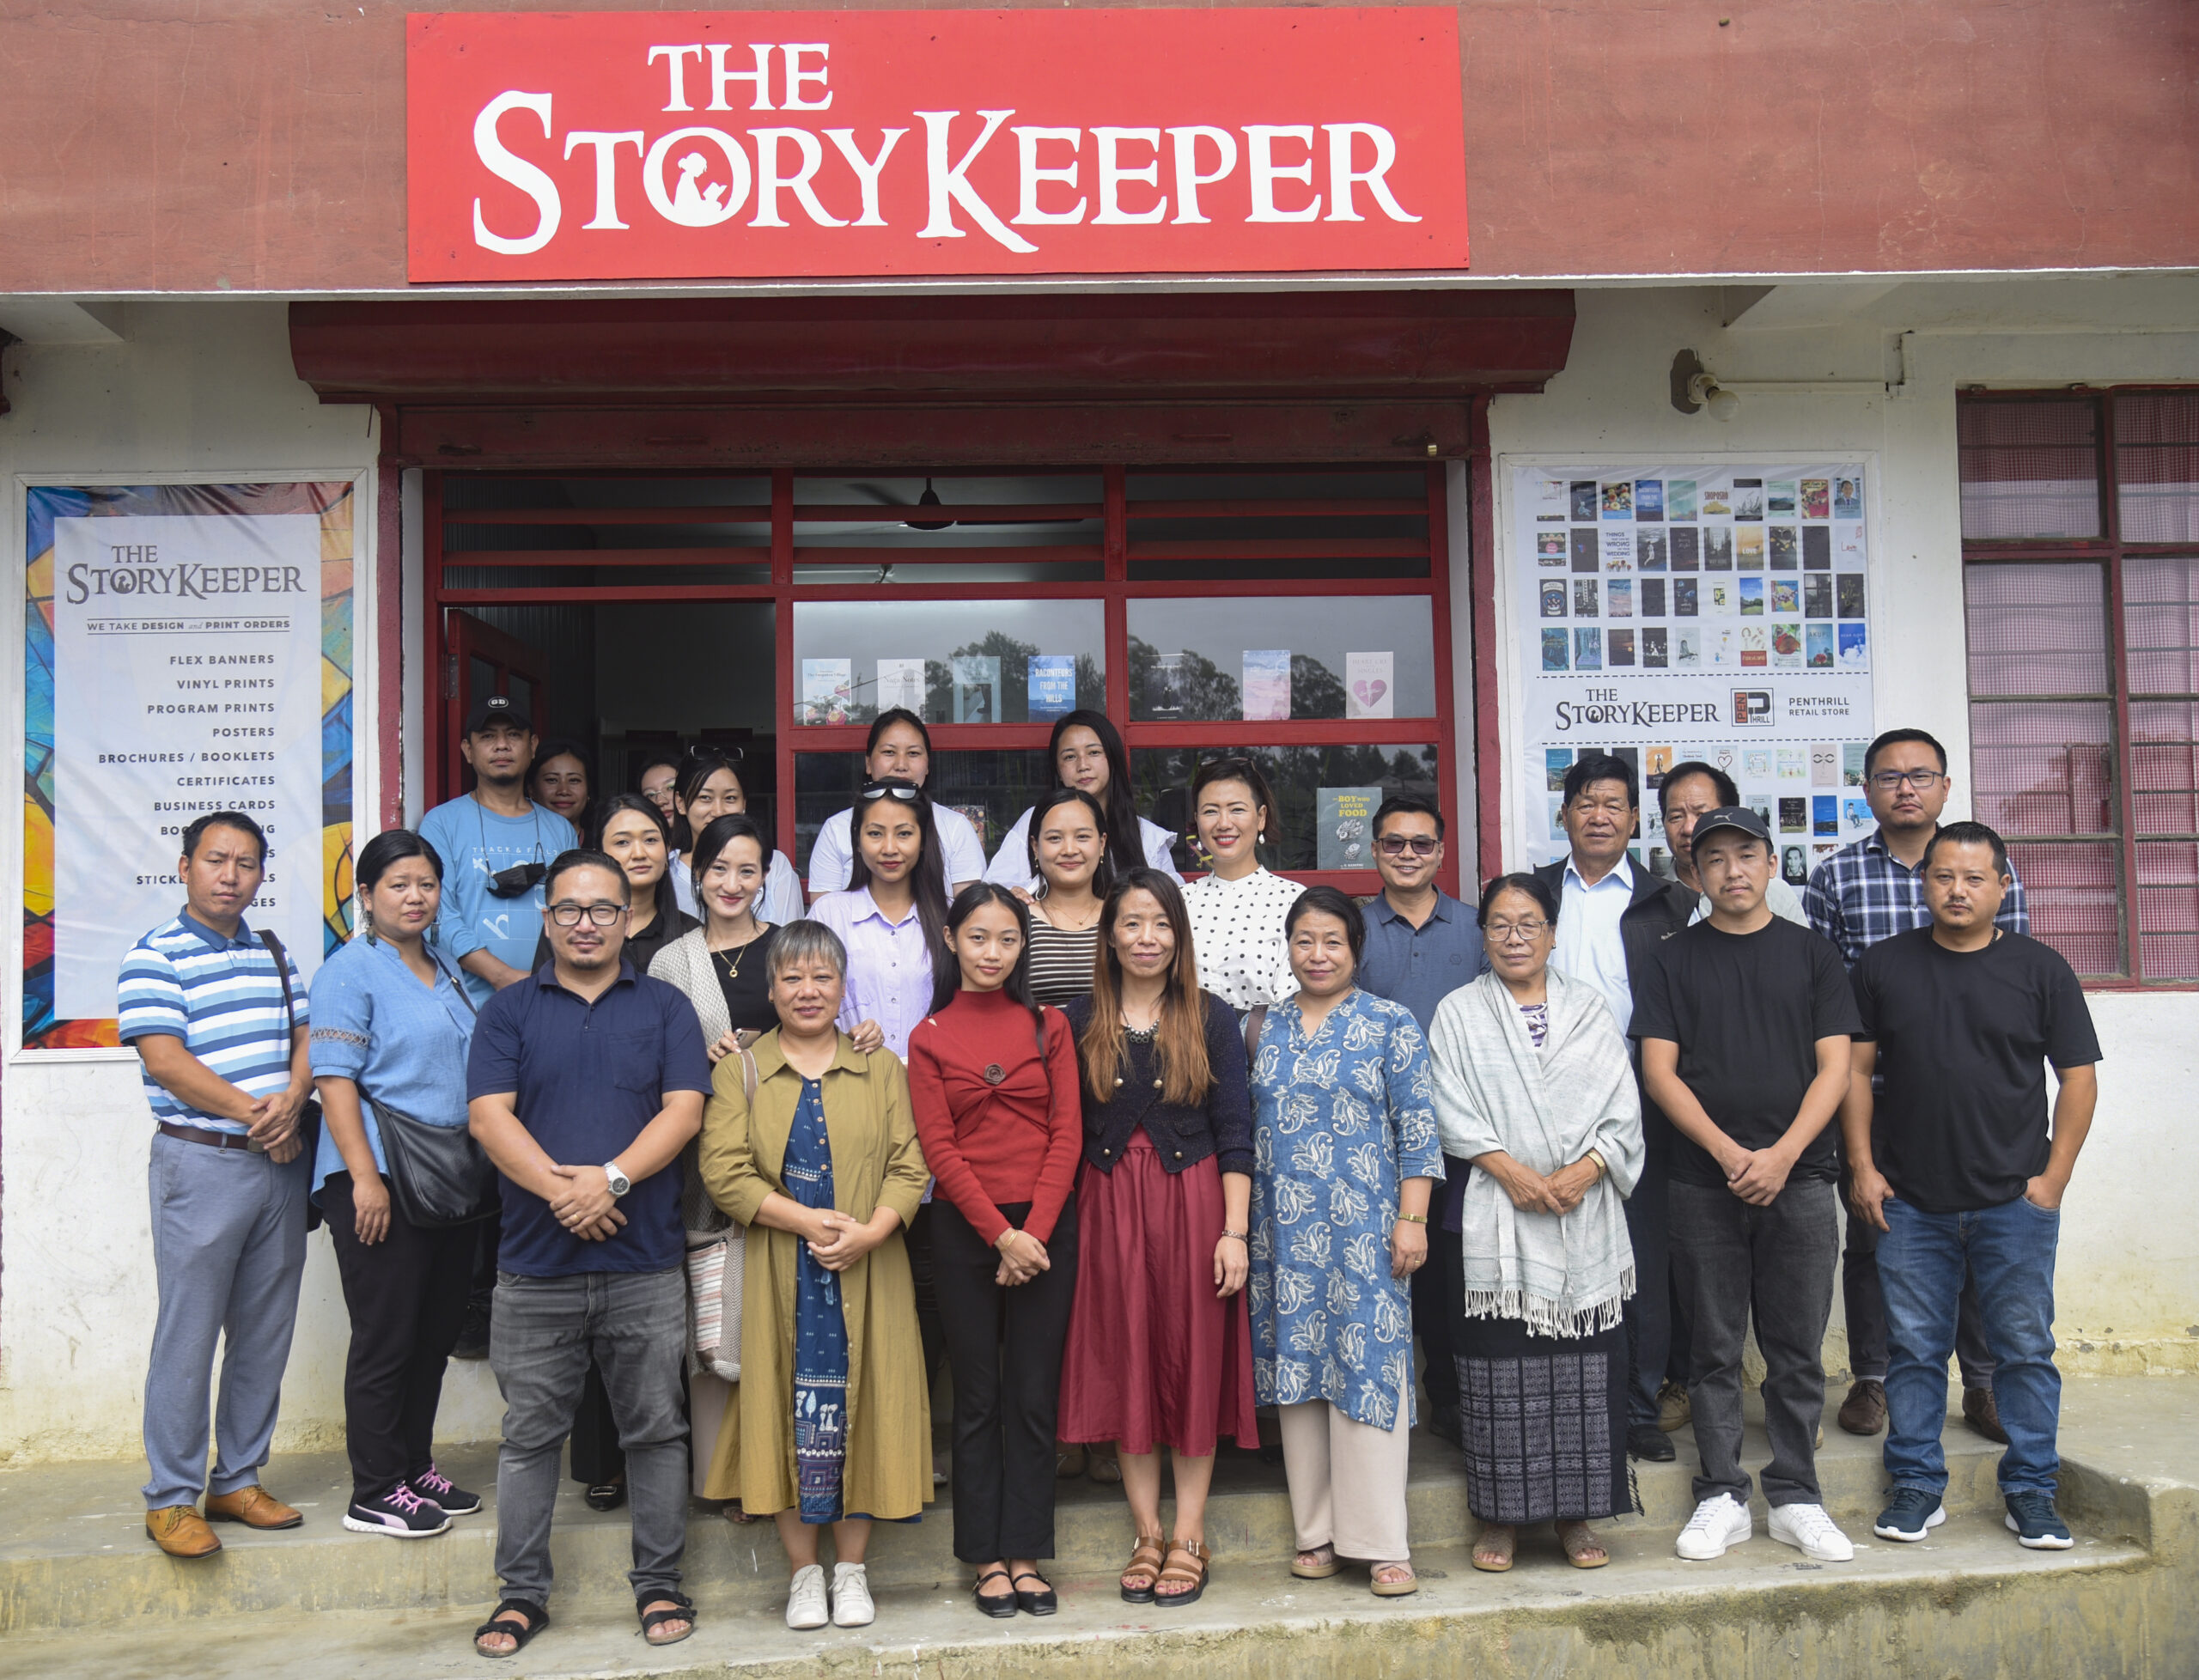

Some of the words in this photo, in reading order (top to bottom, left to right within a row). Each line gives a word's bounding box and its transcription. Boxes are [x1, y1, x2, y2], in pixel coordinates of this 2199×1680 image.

[647, 43, 833, 112] THE
[111, 545, 158, 563] THE
[88, 623, 105, 631] WE
[243, 620, 290, 629] ORDERS
[170, 655, 203, 666] FLEX
[209, 654, 275, 665] BANNERS
[1035, 667, 1073, 678] RACONTEURS
[177, 679, 219, 690] VINYL
[224, 679, 275, 689] PRINTS
[1039, 681, 1057, 691] FROM
[1057, 680, 1069, 691] THE
[1045, 693, 1063, 703] HILLS
[1585, 688, 1618, 701] THE
[1788, 697, 1850, 706] PENTHRILL
[147, 703, 218, 715] PROGRAM
[224, 703, 275, 713] PRINTS
[1737, 697, 1746, 720] PEN
[212, 727, 275, 738] POSTERS
[99, 752, 186, 764] BROCHURES
[201, 752, 275, 762] BOOKLETS
[177, 776, 275, 787] CERTIFICATES
[154, 800, 223, 811] BUSINESS
[228, 800, 276, 810] CARDS
